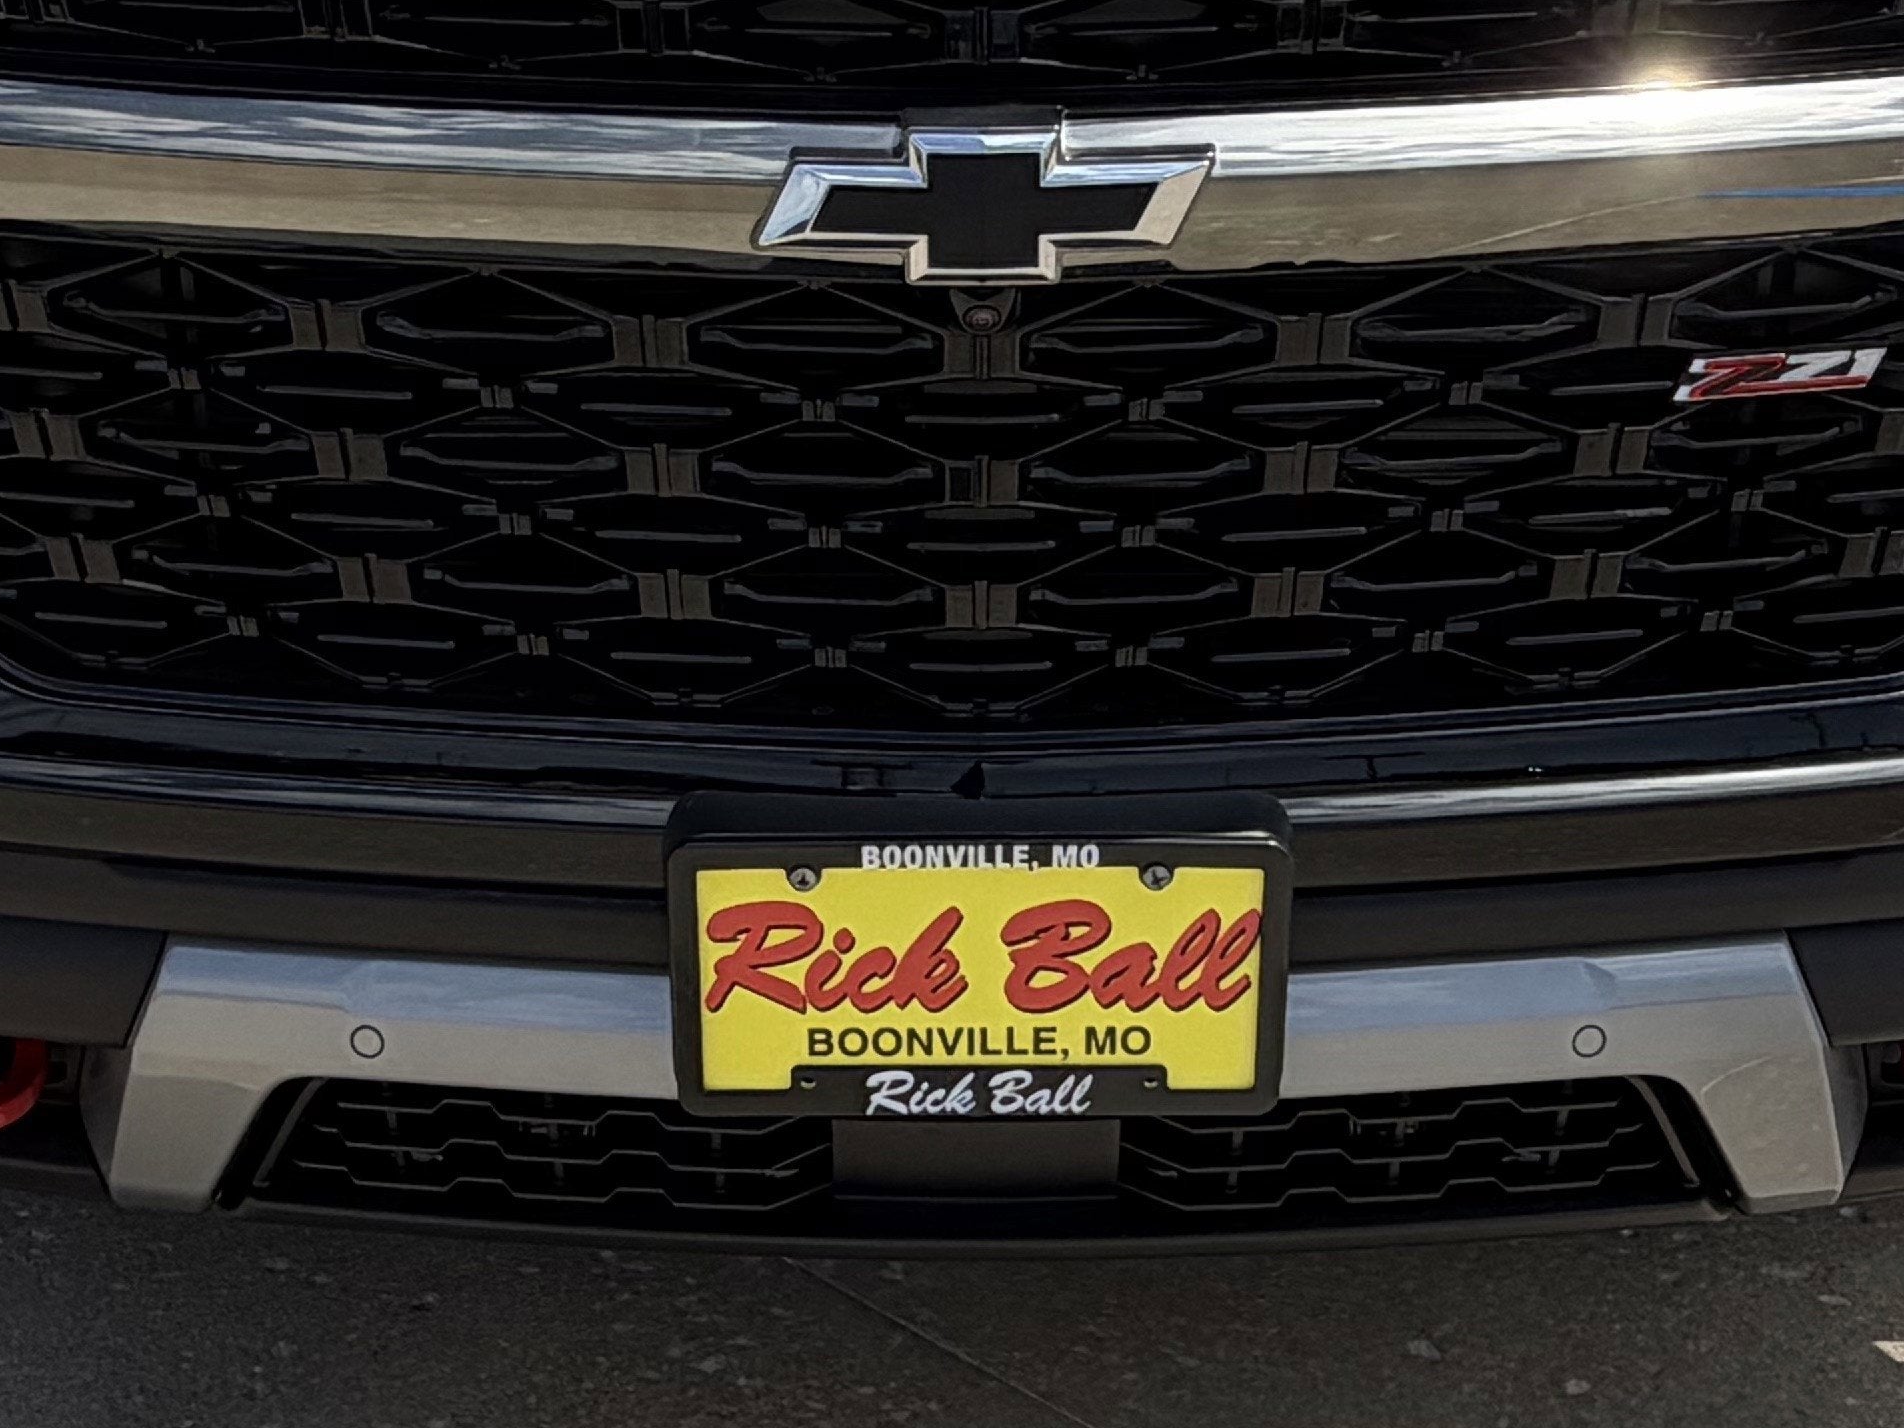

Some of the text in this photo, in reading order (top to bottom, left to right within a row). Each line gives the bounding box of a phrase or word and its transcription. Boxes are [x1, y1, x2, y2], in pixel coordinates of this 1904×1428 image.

[1672, 347, 1888, 402] Z71
[859, 844, 1101, 871] BOONVILLE, MO
[704, 899, 1263, 1015] Rick Ball
[806, 1025, 1153, 1061] BOONVILLE, MO
[864, 1070, 1094, 1116] Rick Ball
